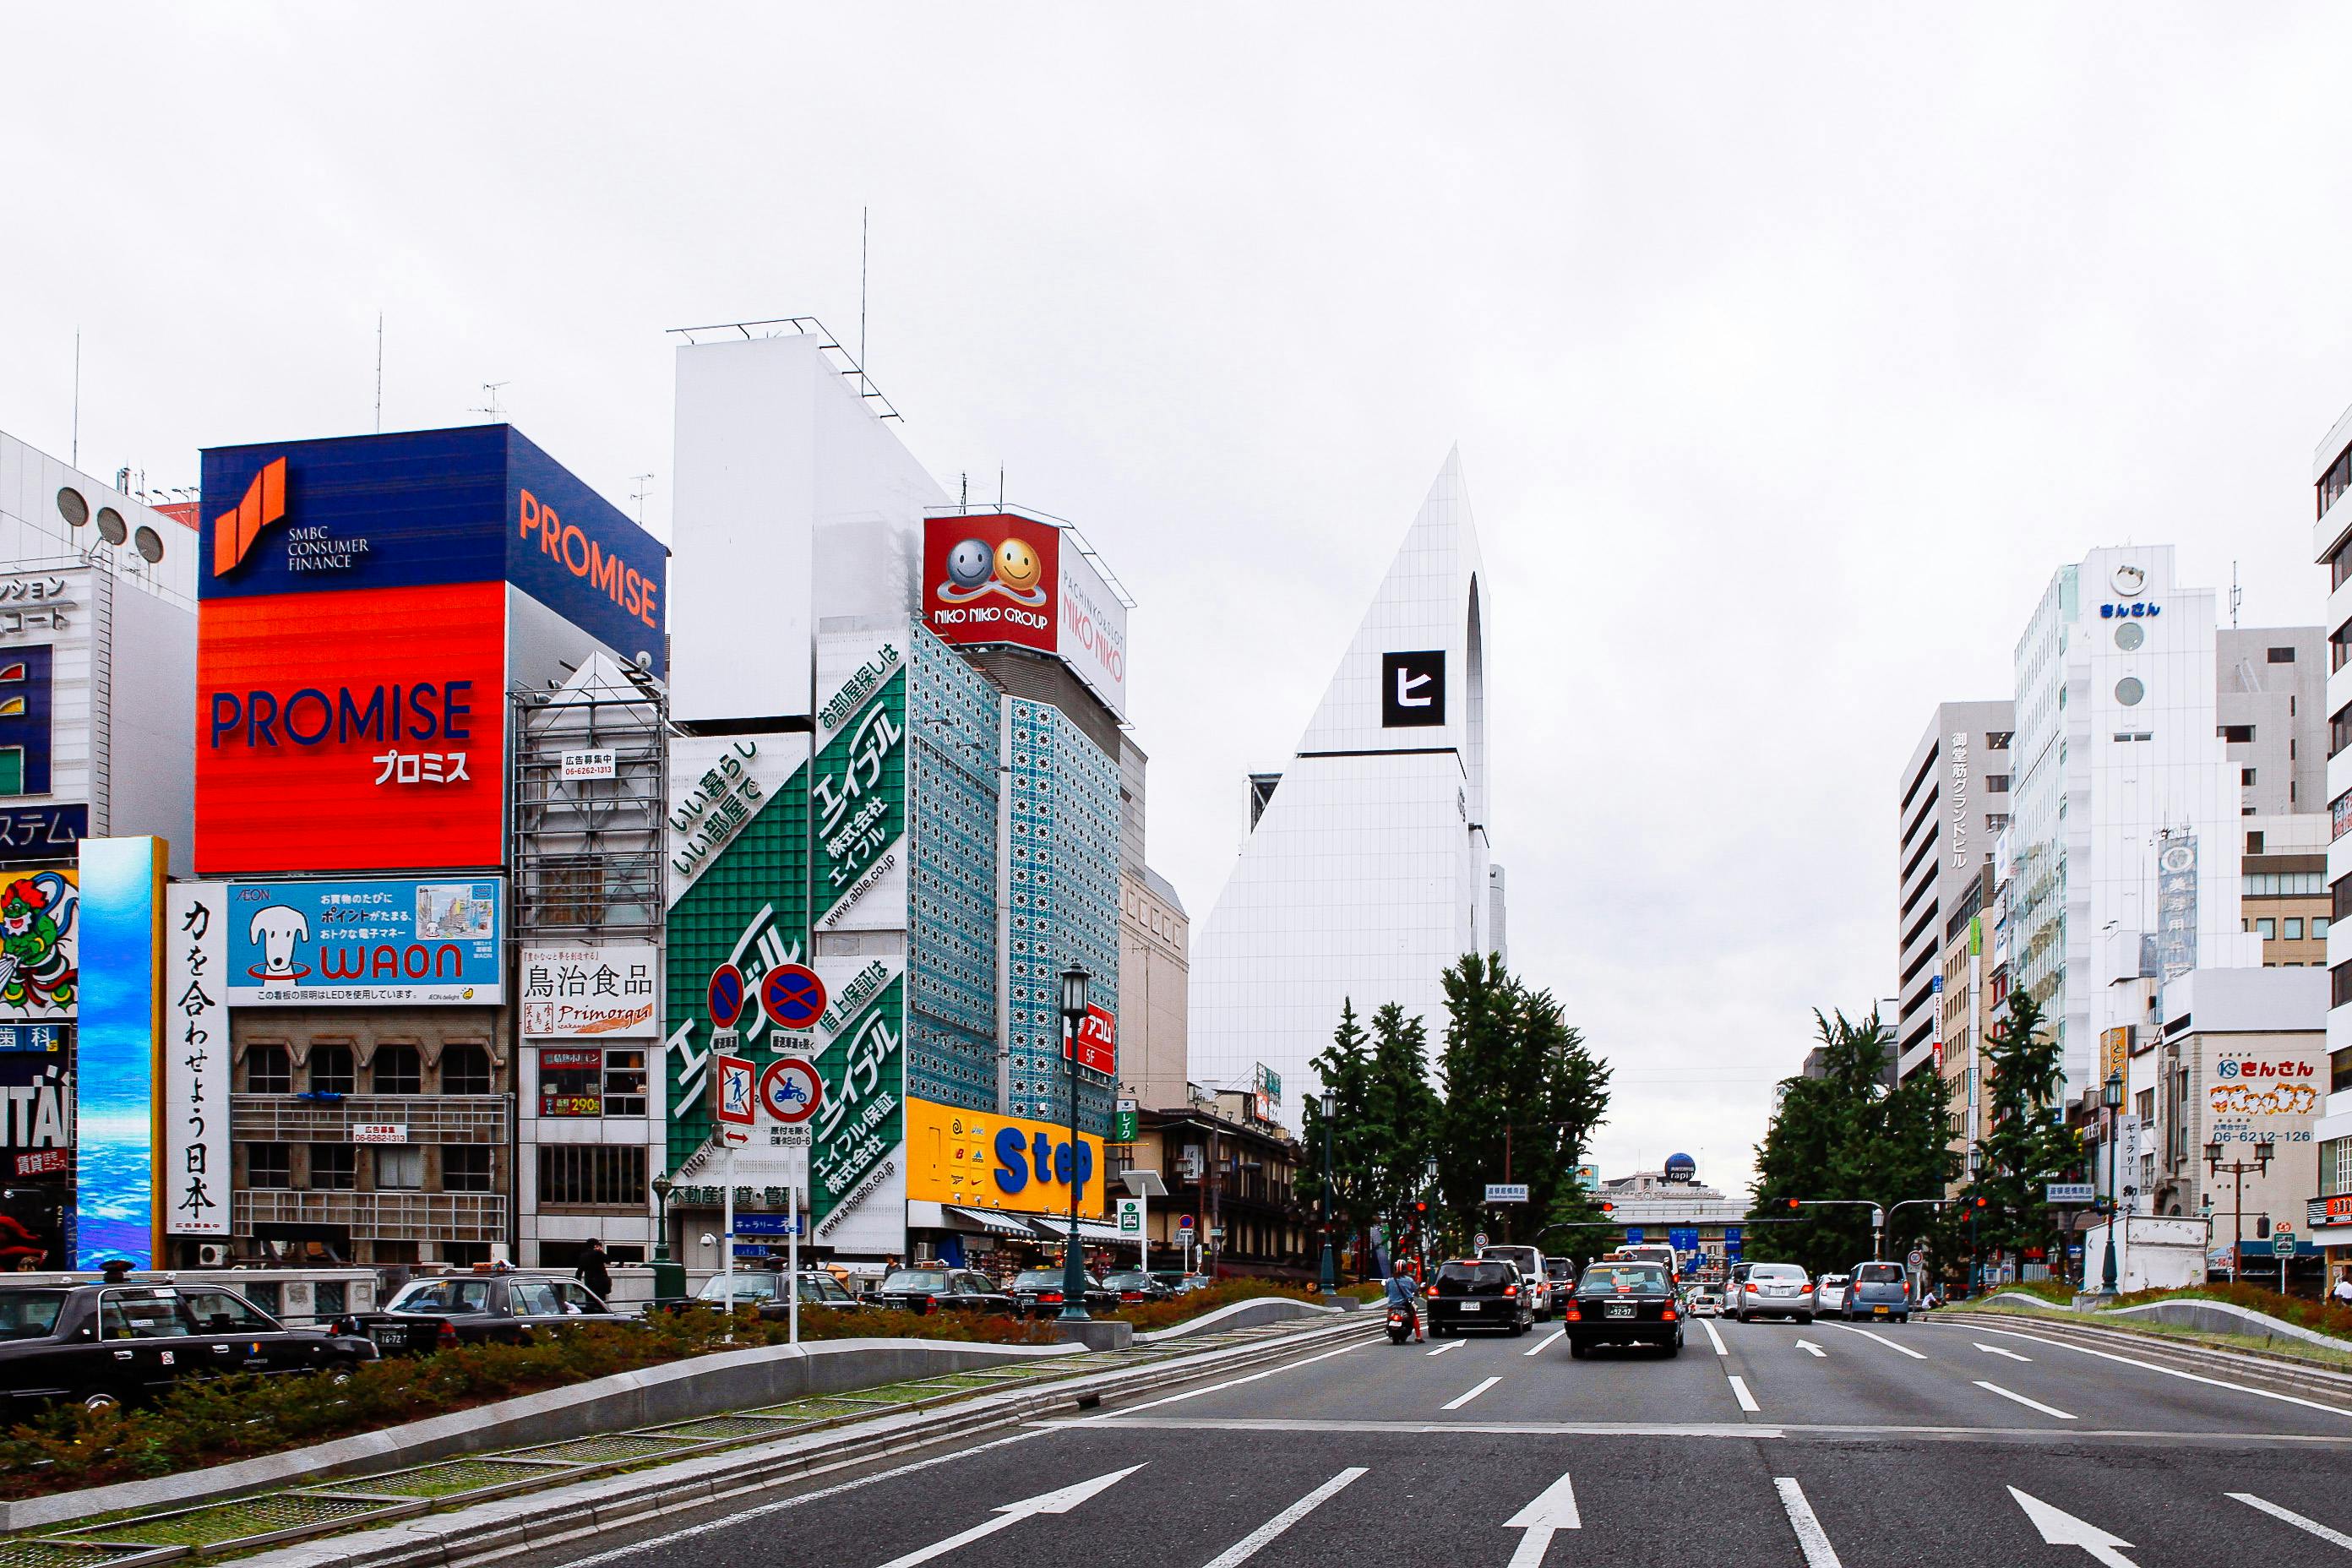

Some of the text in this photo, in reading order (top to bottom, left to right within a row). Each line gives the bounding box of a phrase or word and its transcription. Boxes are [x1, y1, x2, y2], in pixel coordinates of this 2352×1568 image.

[288, 526, 328, 541] SMBC
[288, 539, 369, 557] CONSUMER
[288, 555, 351, 571] FINANCE
[520, 488, 658, 629] PROMISE
[0, 607, 70, 635] コート
[934, 607, 1048, 629] NIKO NIKO GROUP
[1064, 591, 1123, 683] NIKO NIKO
[818, 642, 899, 729] お部屋探しは
[1397, 667, 1432, 707] ヒ
[211, 681, 472, 749] PROMISE
[373, 750, 471, 786] プロミス
[565, 754, 612, 766] 広告募集中
[565, 765, 612, 776] 06-6262-1313
[813, 700, 901, 839] エイブル
[669, 741, 758, 834] いい暮らし
[1952, 732, 1968, 868] 御堂筋グランドビル
[672, 776, 764, 875] いい部屋で
[825, 795, 888, 859] 株式会社
[828, 827, 886, 887] エイブル
[824, 853, 896, 928] www.able.co.jp
[321, 906, 412, 923] ポイントがたまる、
[320, 928, 406, 939] おトクな電子マネー
[320, 944, 464, 979] WAON
[258, 988, 417, 1001] この看板の照明はLEDを使用しています。
[524, 963, 652, 998] 鳥治食品
[819, 959, 889, 1035] 借上保証は
[1087, 1014, 1112, 1044] アコム
[177, 900, 216, 1219] 力を合わせよう日本
[1086, 1048, 1096, 1064] 5F
[2240, 1060, 2314, 1077] きんさん
[355, 1134, 406, 1142] 06-6262-1313
[365, 1125, 395, 1134] 広告募集
[813, 1090, 897, 1178] エイブル保証
[1121, 1113, 1131, 1139] レイク
[2213, 1131, 2314, 1142] 06-6212-126
[825, 1135, 887, 1196] 株式会社
[994, 1127, 1092, 1201] Step
[818, 1160, 896, 1239] www.a-hosho.co.jp
